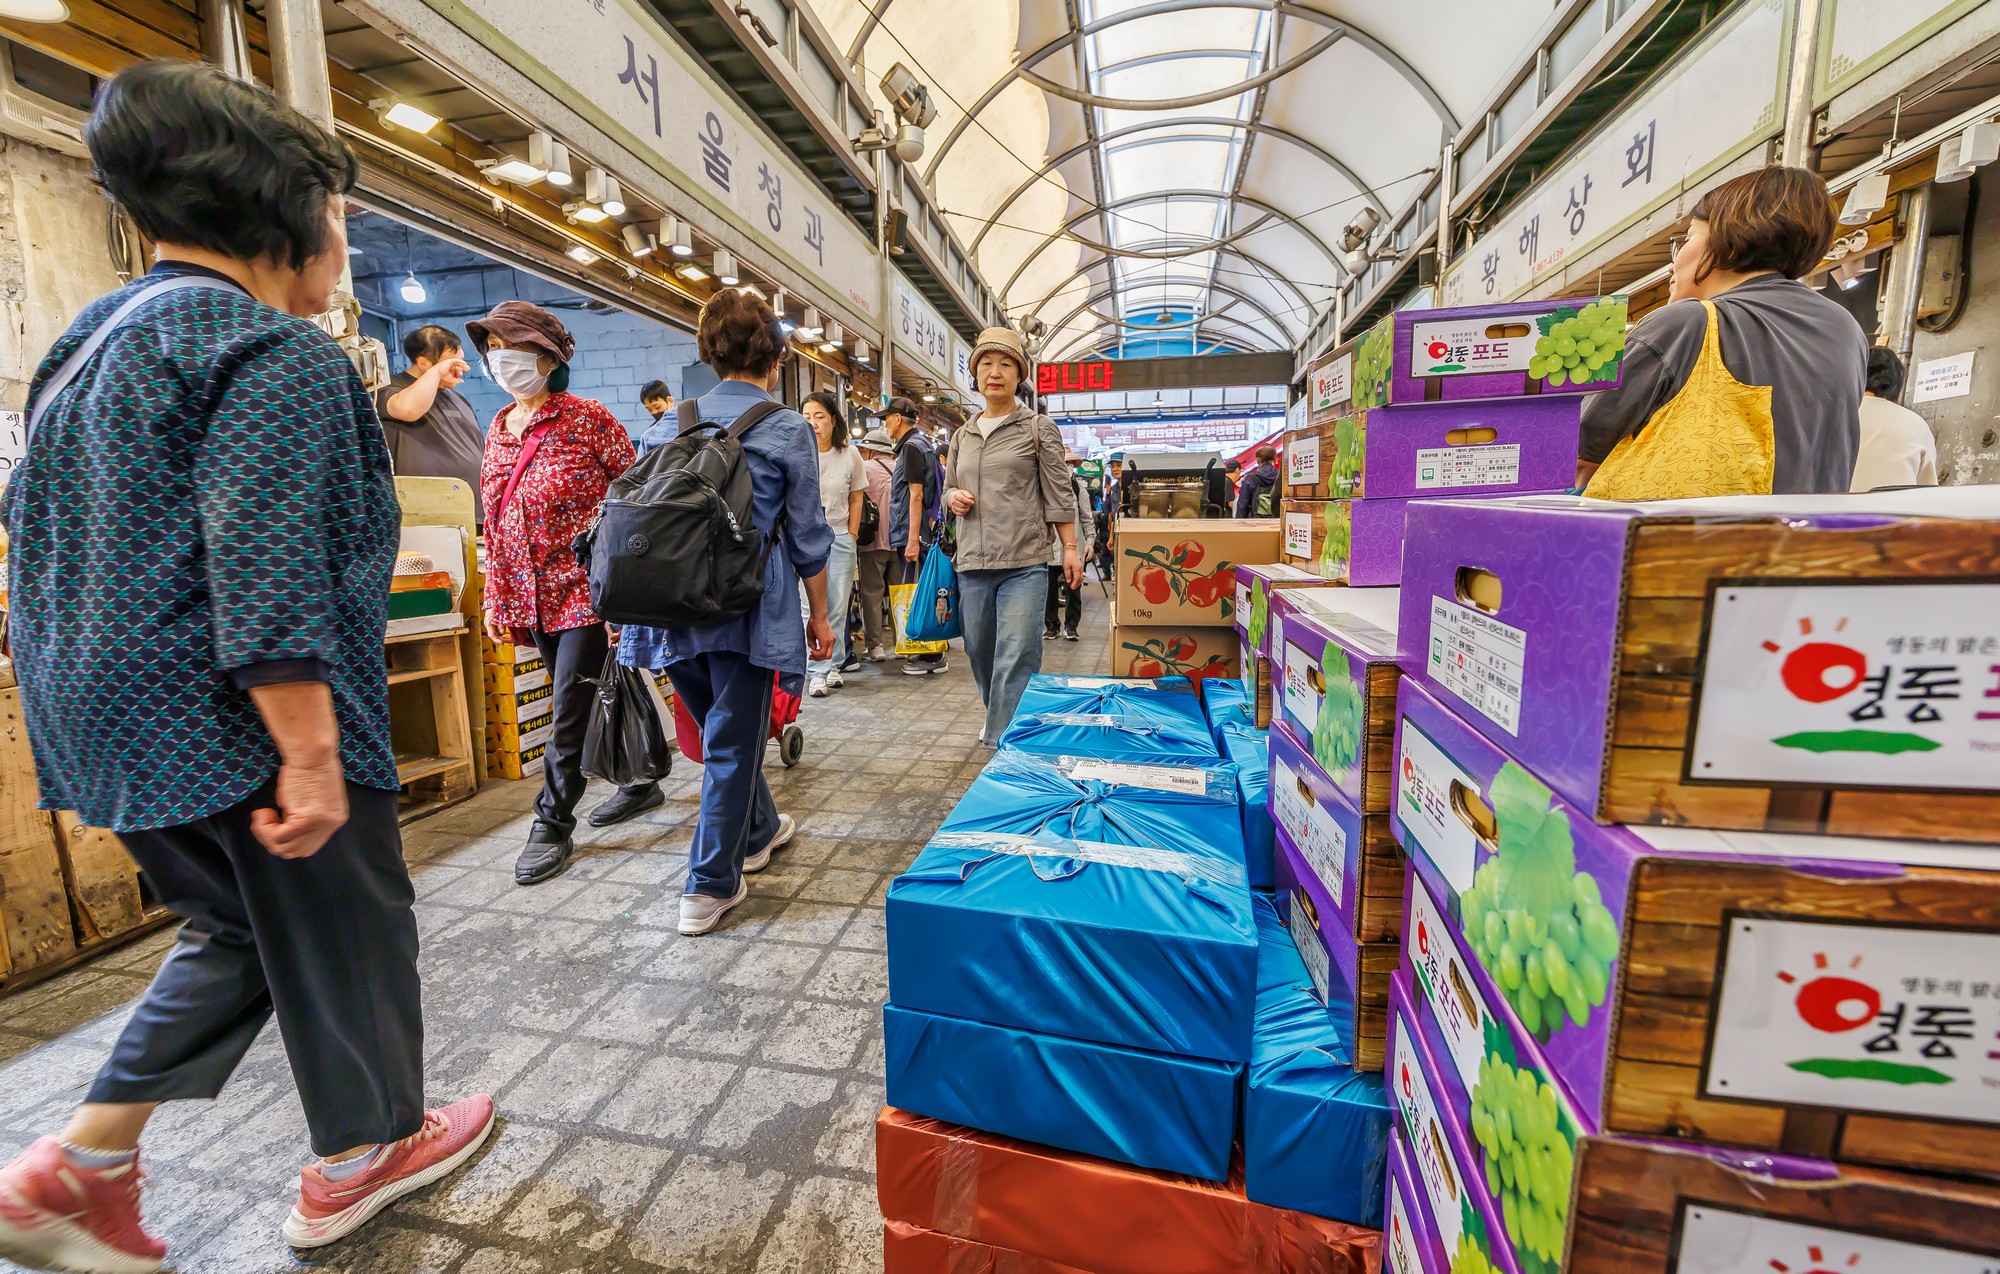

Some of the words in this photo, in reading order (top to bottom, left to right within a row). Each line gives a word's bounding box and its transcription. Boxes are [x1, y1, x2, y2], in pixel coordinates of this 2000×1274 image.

[617, 34, 825, 267] 서울청과
[1481, 118, 1657, 296] 황해상회
[899, 294, 946, 367] 풍남상회
[1472, 342, 1509, 361] 포도
[1132, 609, 1152, 619] 10kg
[1424, 786, 1445, 828] 포도
[1438, 973, 1462, 1043] 포도
